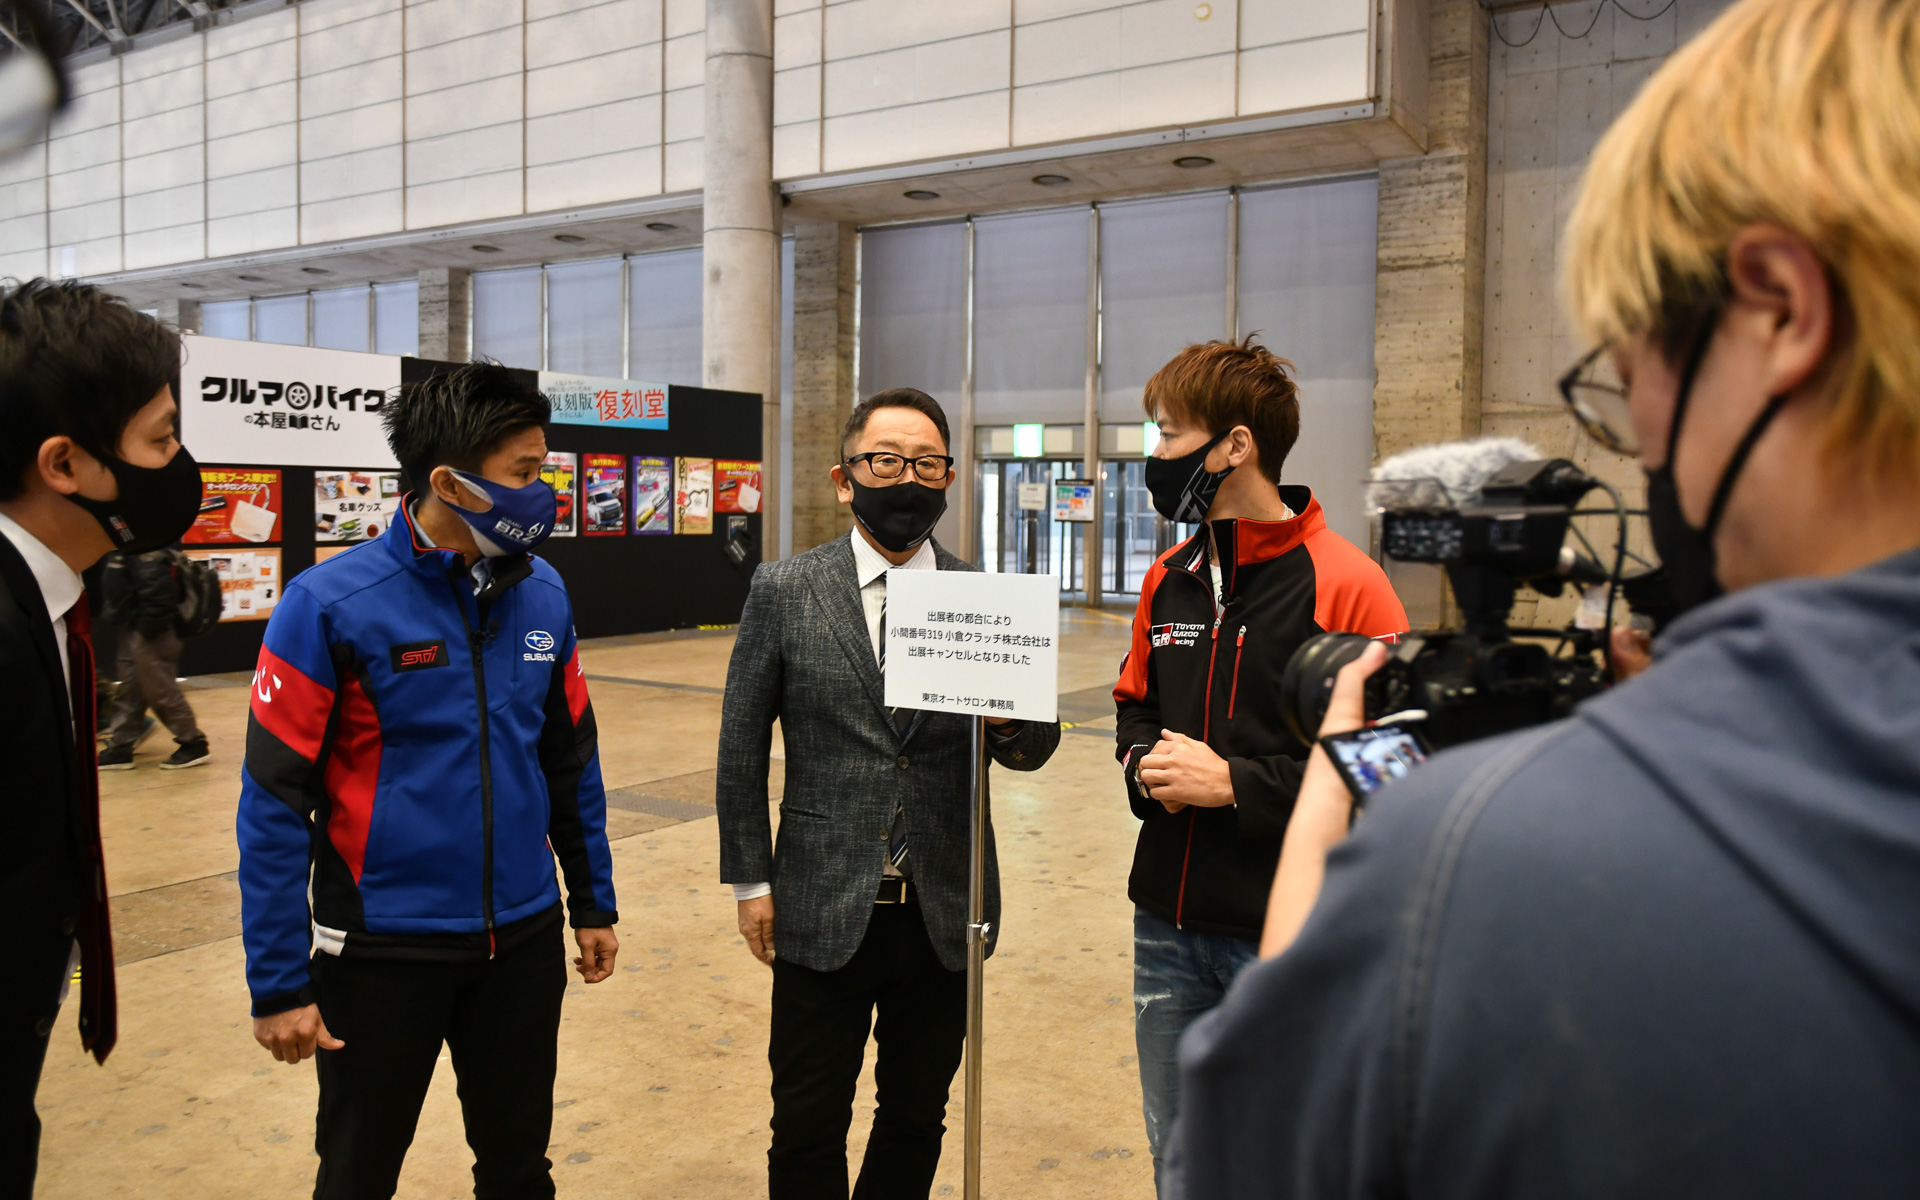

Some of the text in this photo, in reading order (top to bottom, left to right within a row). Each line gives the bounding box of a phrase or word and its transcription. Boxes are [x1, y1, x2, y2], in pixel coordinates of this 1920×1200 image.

[595, 388, 667, 422] 復刻堂
[339, 502, 382, 512] 名車グッズ
[927, 611, 1012, 626] 出展者の都合により
[1172, 630, 1199, 638] GAZOO
[1174, 623, 1205, 631] TOYOTA
[890, 627, 1051, 648] 小間番号319 小倉クラッチ株式会社は
[1170, 637, 1195, 647] Racing
[908, 646, 1031, 665] 出展キャンセルとなりました
[922, 692, 1014, 711] 東京オートサロン事務局
